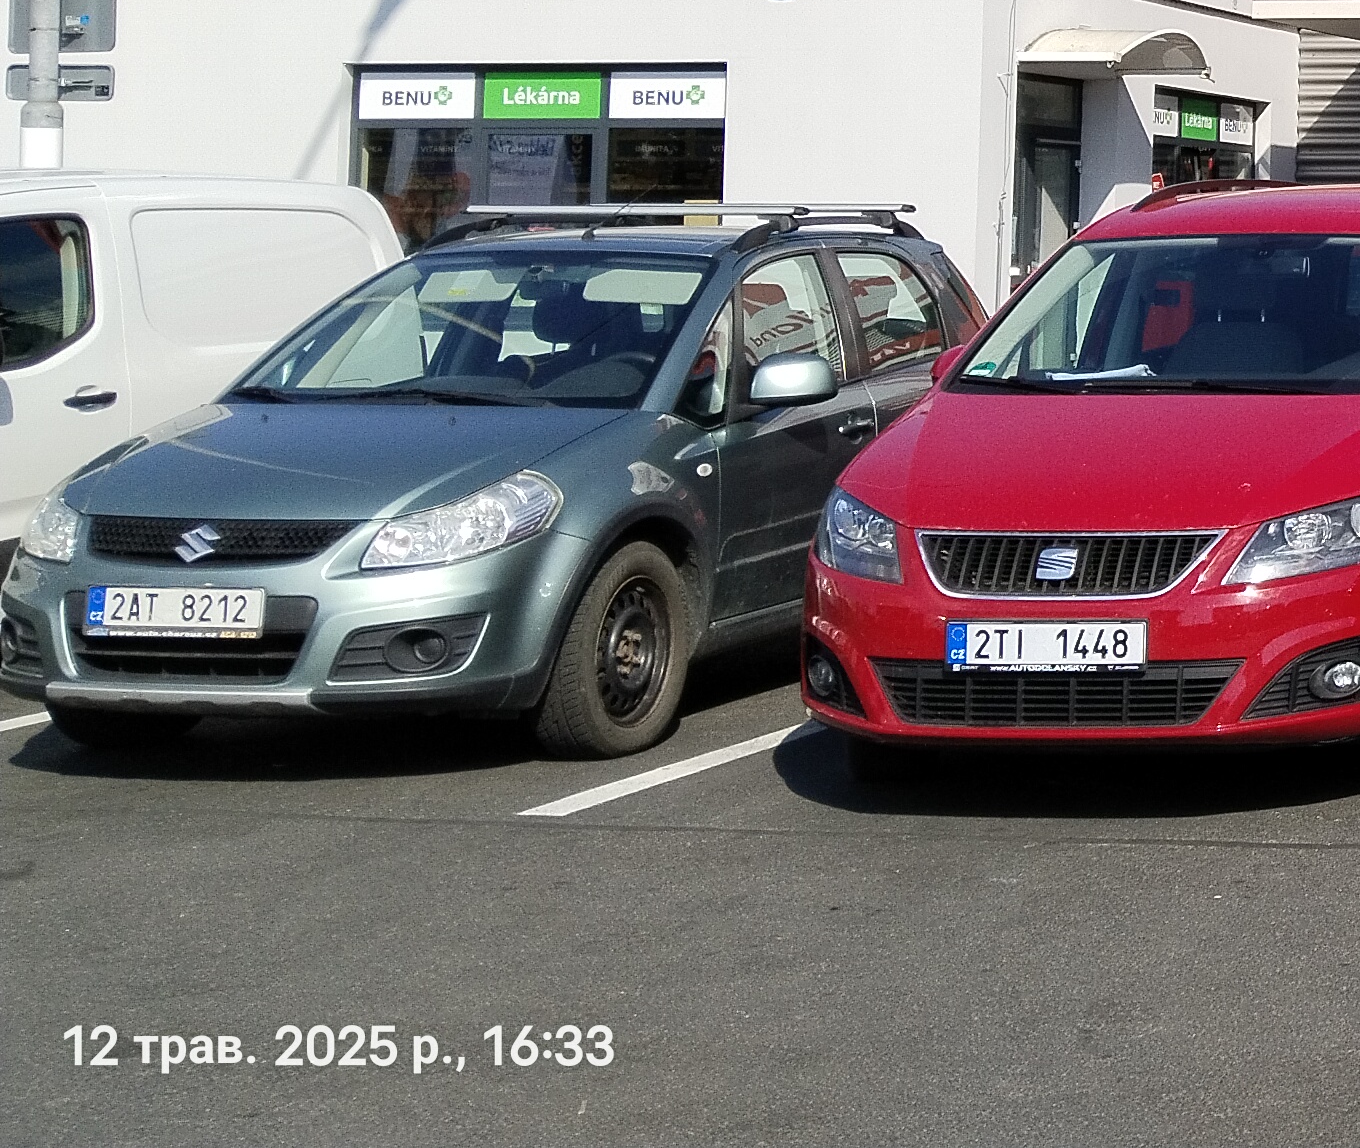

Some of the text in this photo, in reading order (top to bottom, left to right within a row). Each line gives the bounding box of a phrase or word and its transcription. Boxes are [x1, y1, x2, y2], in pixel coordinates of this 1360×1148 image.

[382, 90, 432, 106] BENU
[502, 85, 580, 105] Lékárna
[632, 89, 684, 105] BENU
[89, 611, 104, 621] CZ
[110, 592, 248, 624] 2AT 8212
[974, 628, 1129, 660] 2TI 1448
[950, 649, 966, 659] CZ
